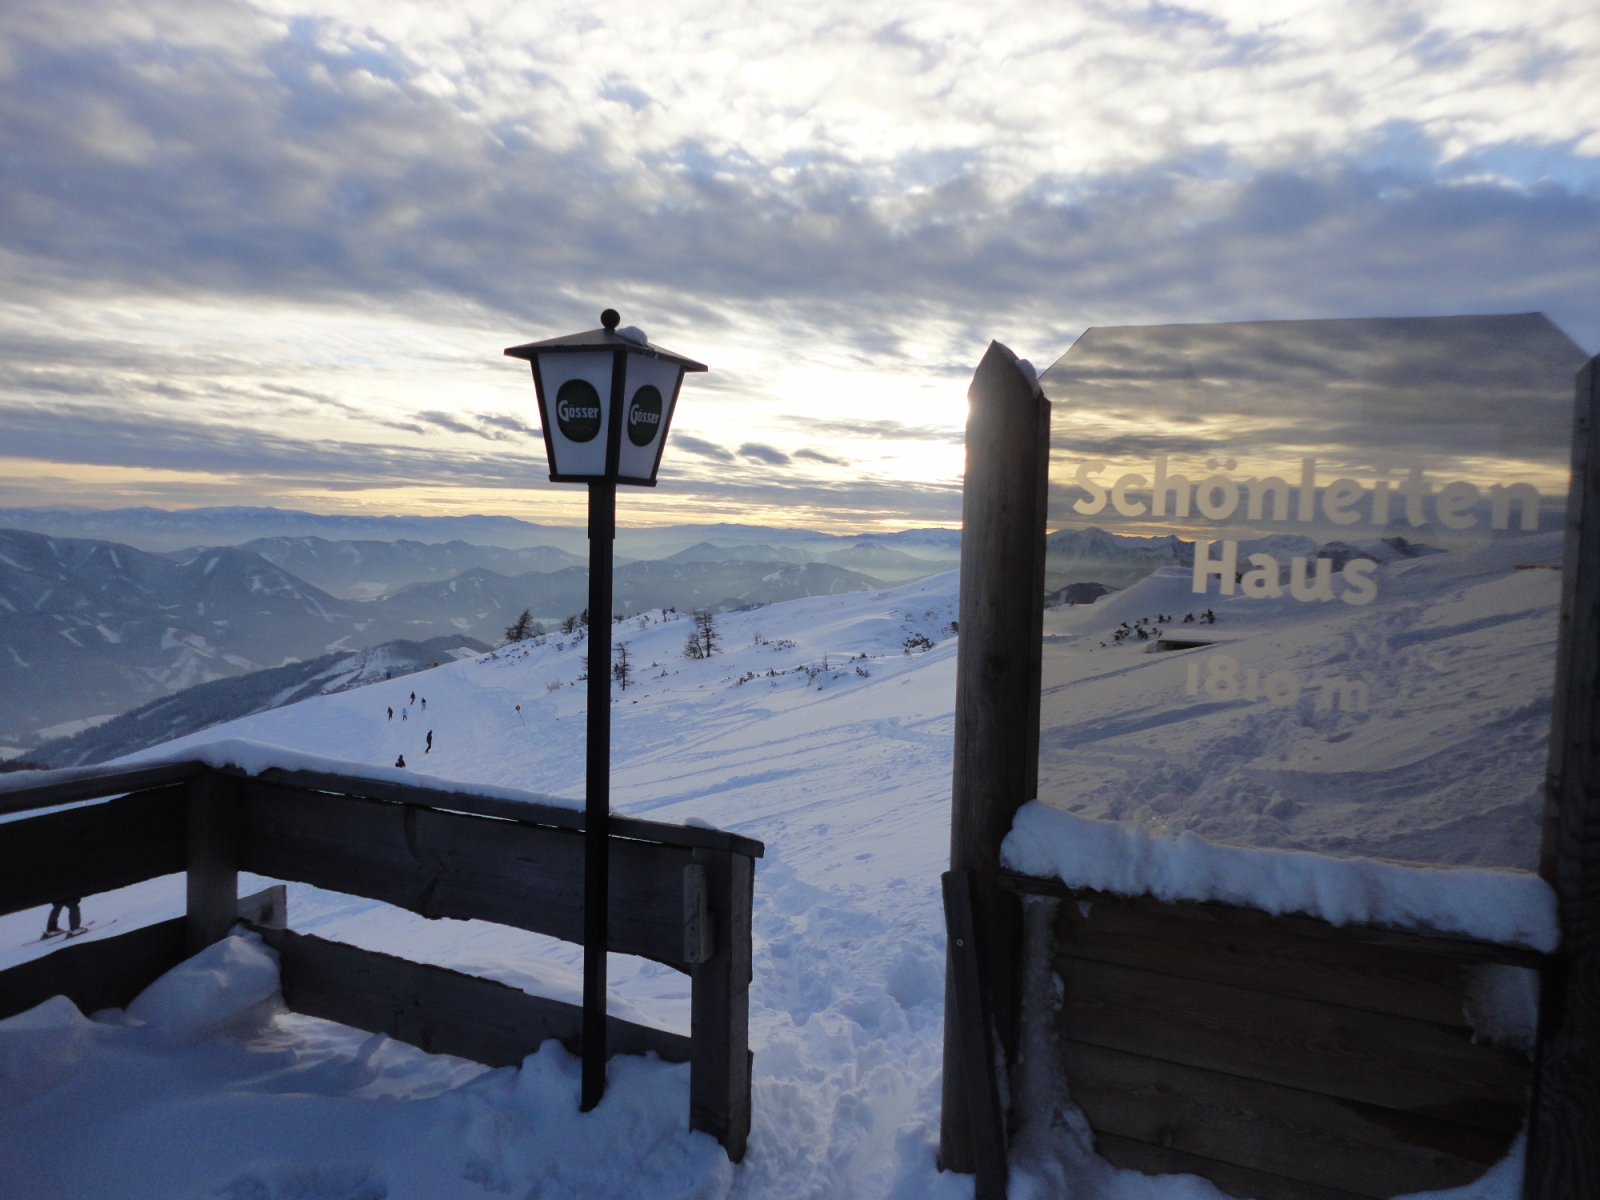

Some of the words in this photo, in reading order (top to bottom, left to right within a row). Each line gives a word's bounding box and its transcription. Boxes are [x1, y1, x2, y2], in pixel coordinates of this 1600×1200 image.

[558, 400, 599, 422] Gösser
[630, 403, 660, 426] Gösser
[1072, 455, 1541, 531] Schönleiten
[1192, 540, 1379, 606] Haus
[1186, 654, 1302, 706] 1810
[1313, 677, 1371, 713] m
